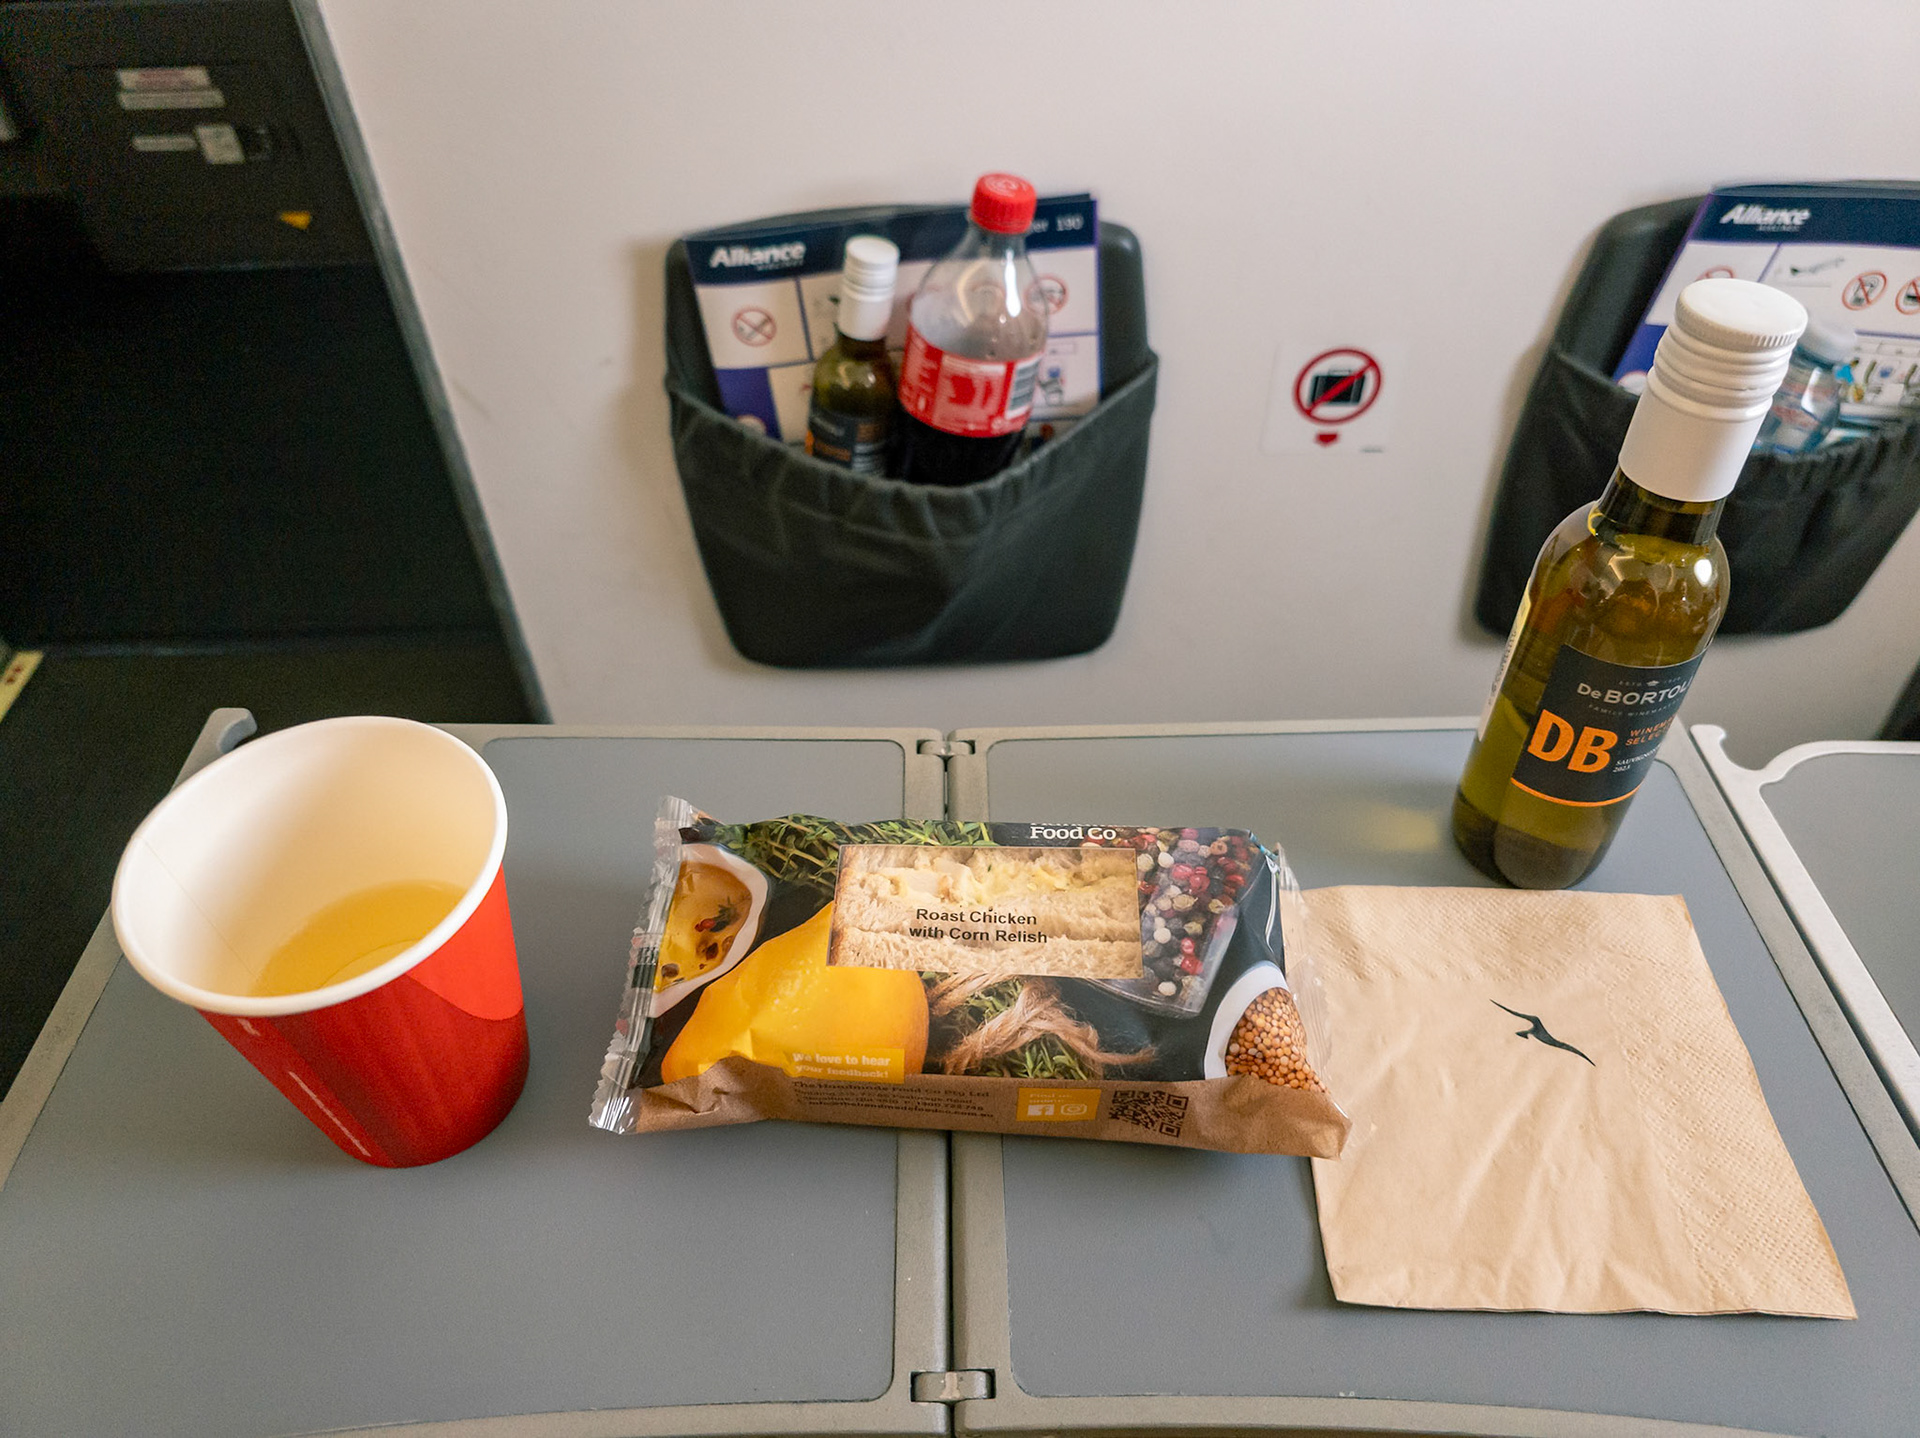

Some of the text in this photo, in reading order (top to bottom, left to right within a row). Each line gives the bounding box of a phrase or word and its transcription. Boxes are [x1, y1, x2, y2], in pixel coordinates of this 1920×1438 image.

[1719, 203, 1812, 225] Alliance
[709, 241, 806, 268] Alliance
[1527, 709, 1619, 773] DB
[1030, 826, 1117, 840] Food Co
[916, 908, 1037, 925] Roast Chicken
[909, 926, 1048, 944] with Corn Relish
[793, 1052, 891, 1067] We love to hear
